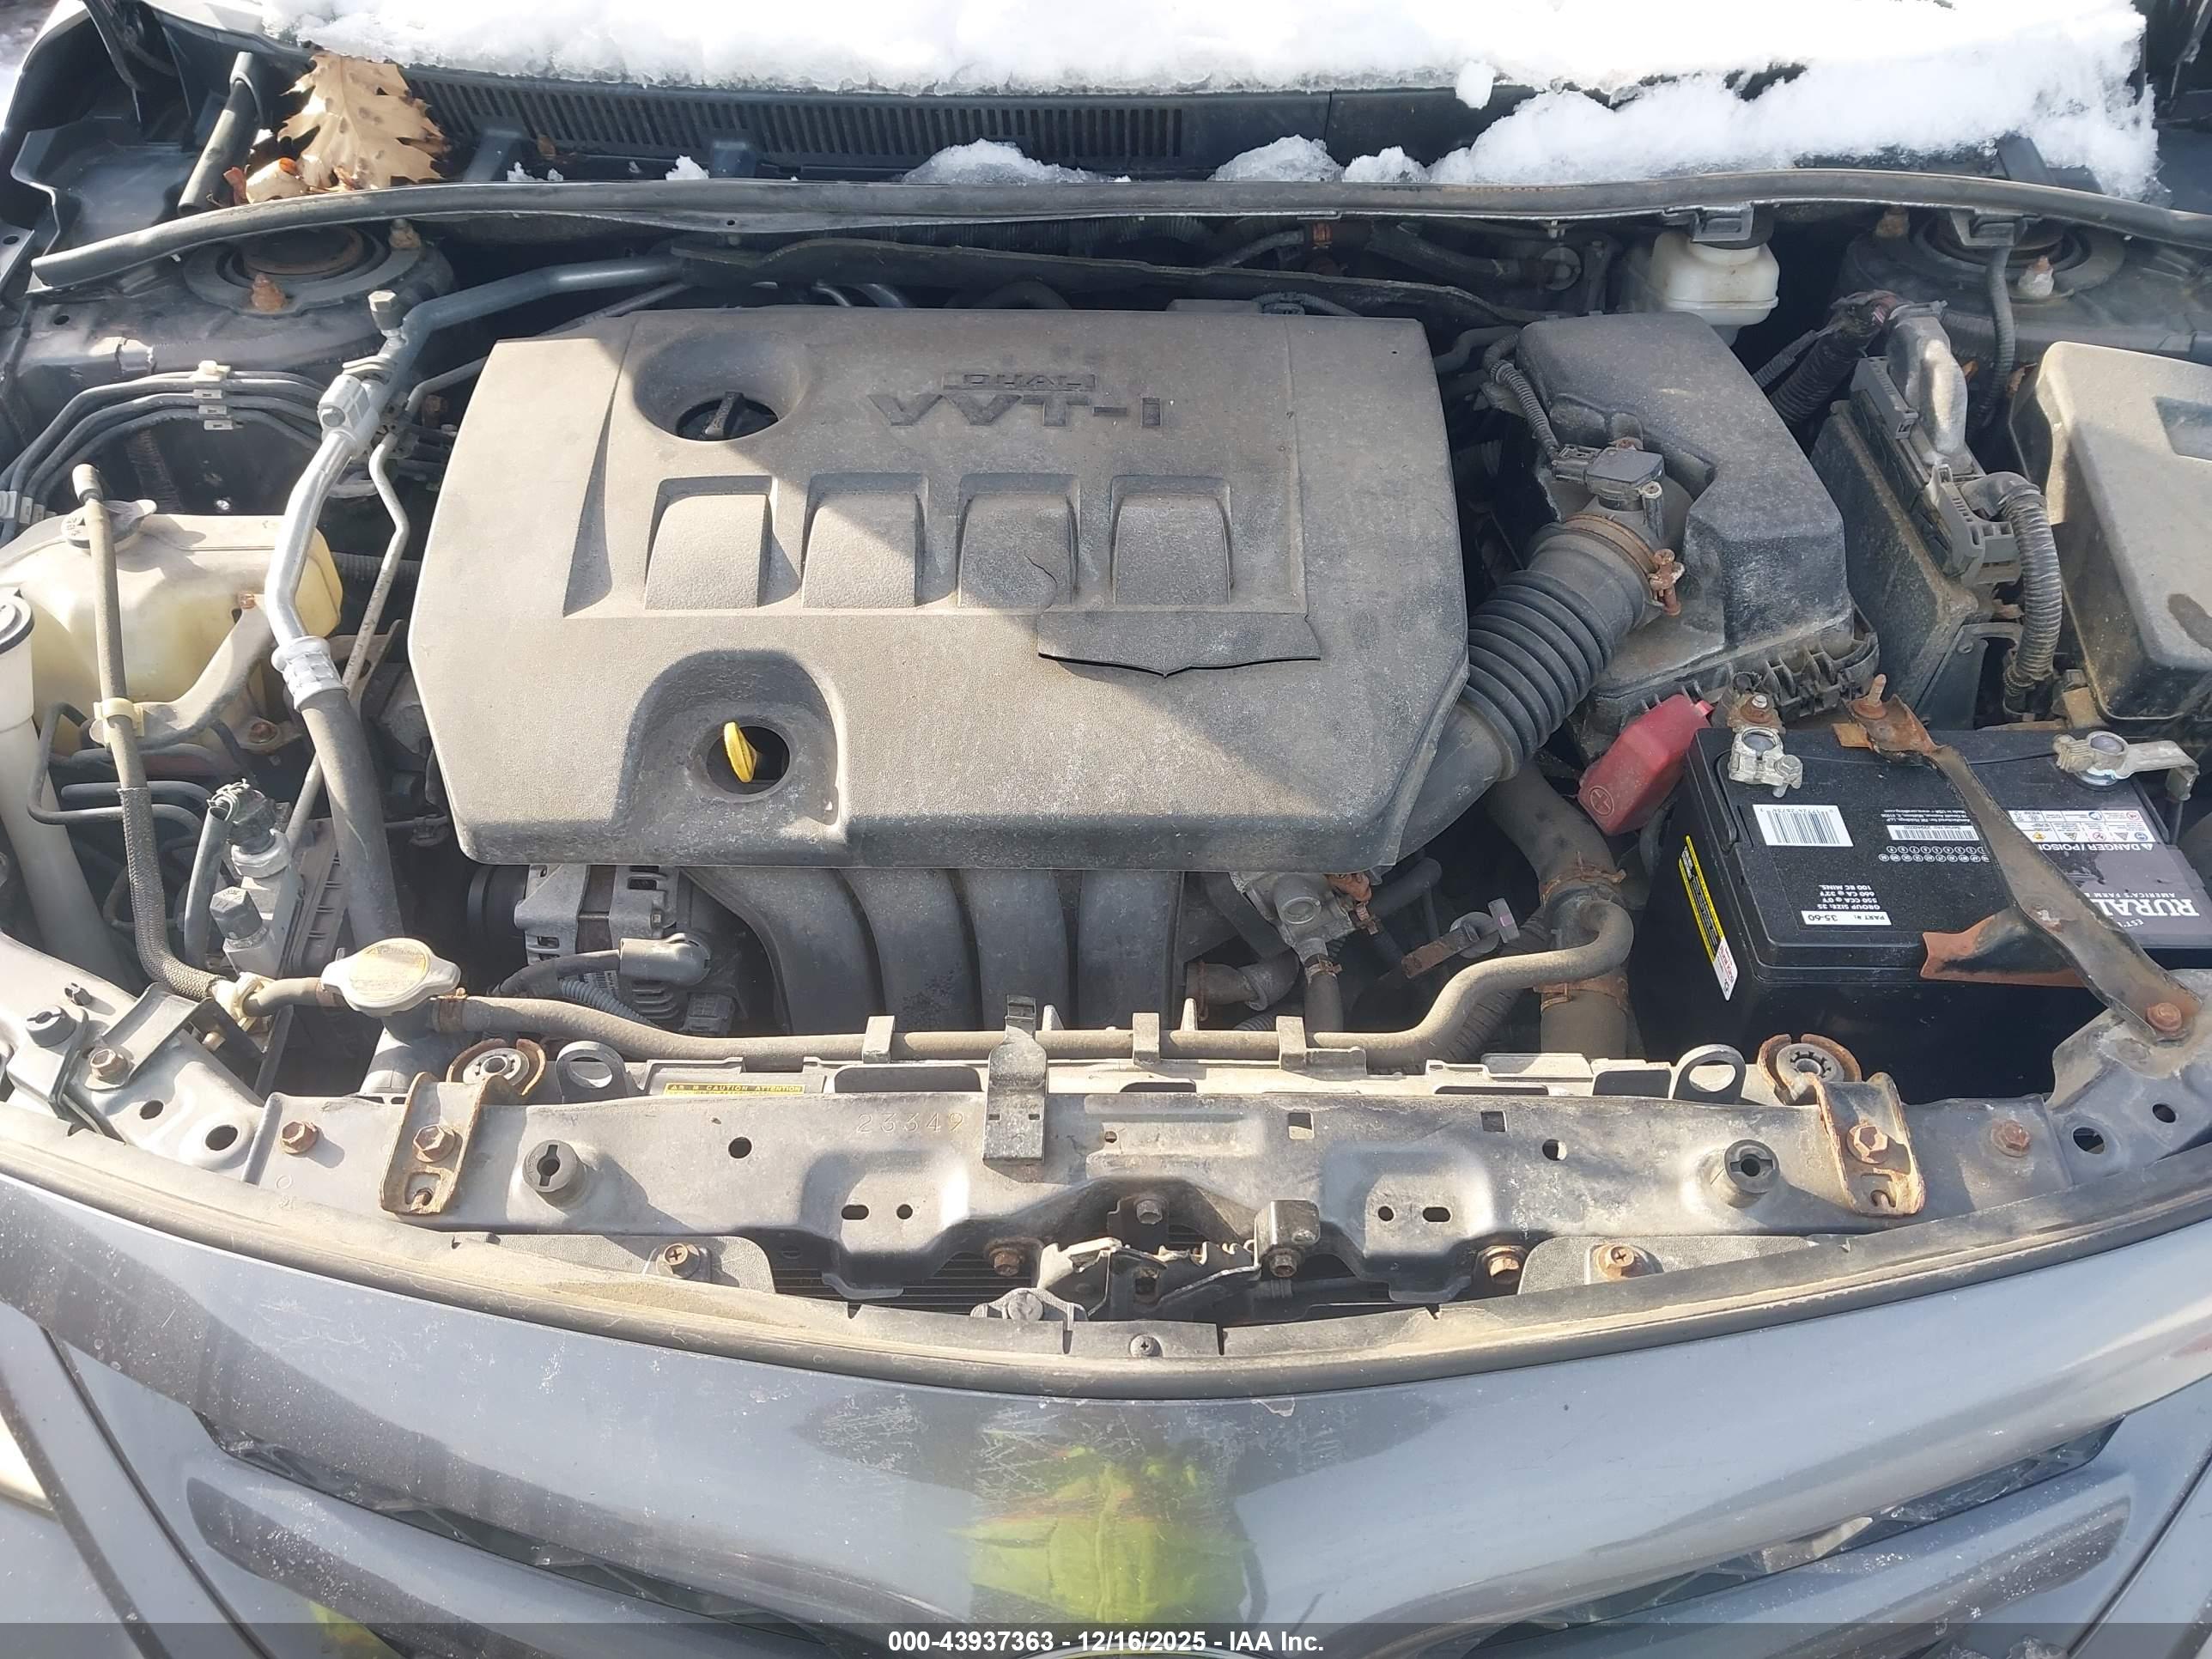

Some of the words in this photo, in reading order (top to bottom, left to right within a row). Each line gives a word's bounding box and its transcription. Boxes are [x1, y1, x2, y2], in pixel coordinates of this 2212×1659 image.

[963, 373, 1084, 386] DUAL
[2091, 898, 2200, 917] RURAL
[857, 1112, 964, 1133] 23349
